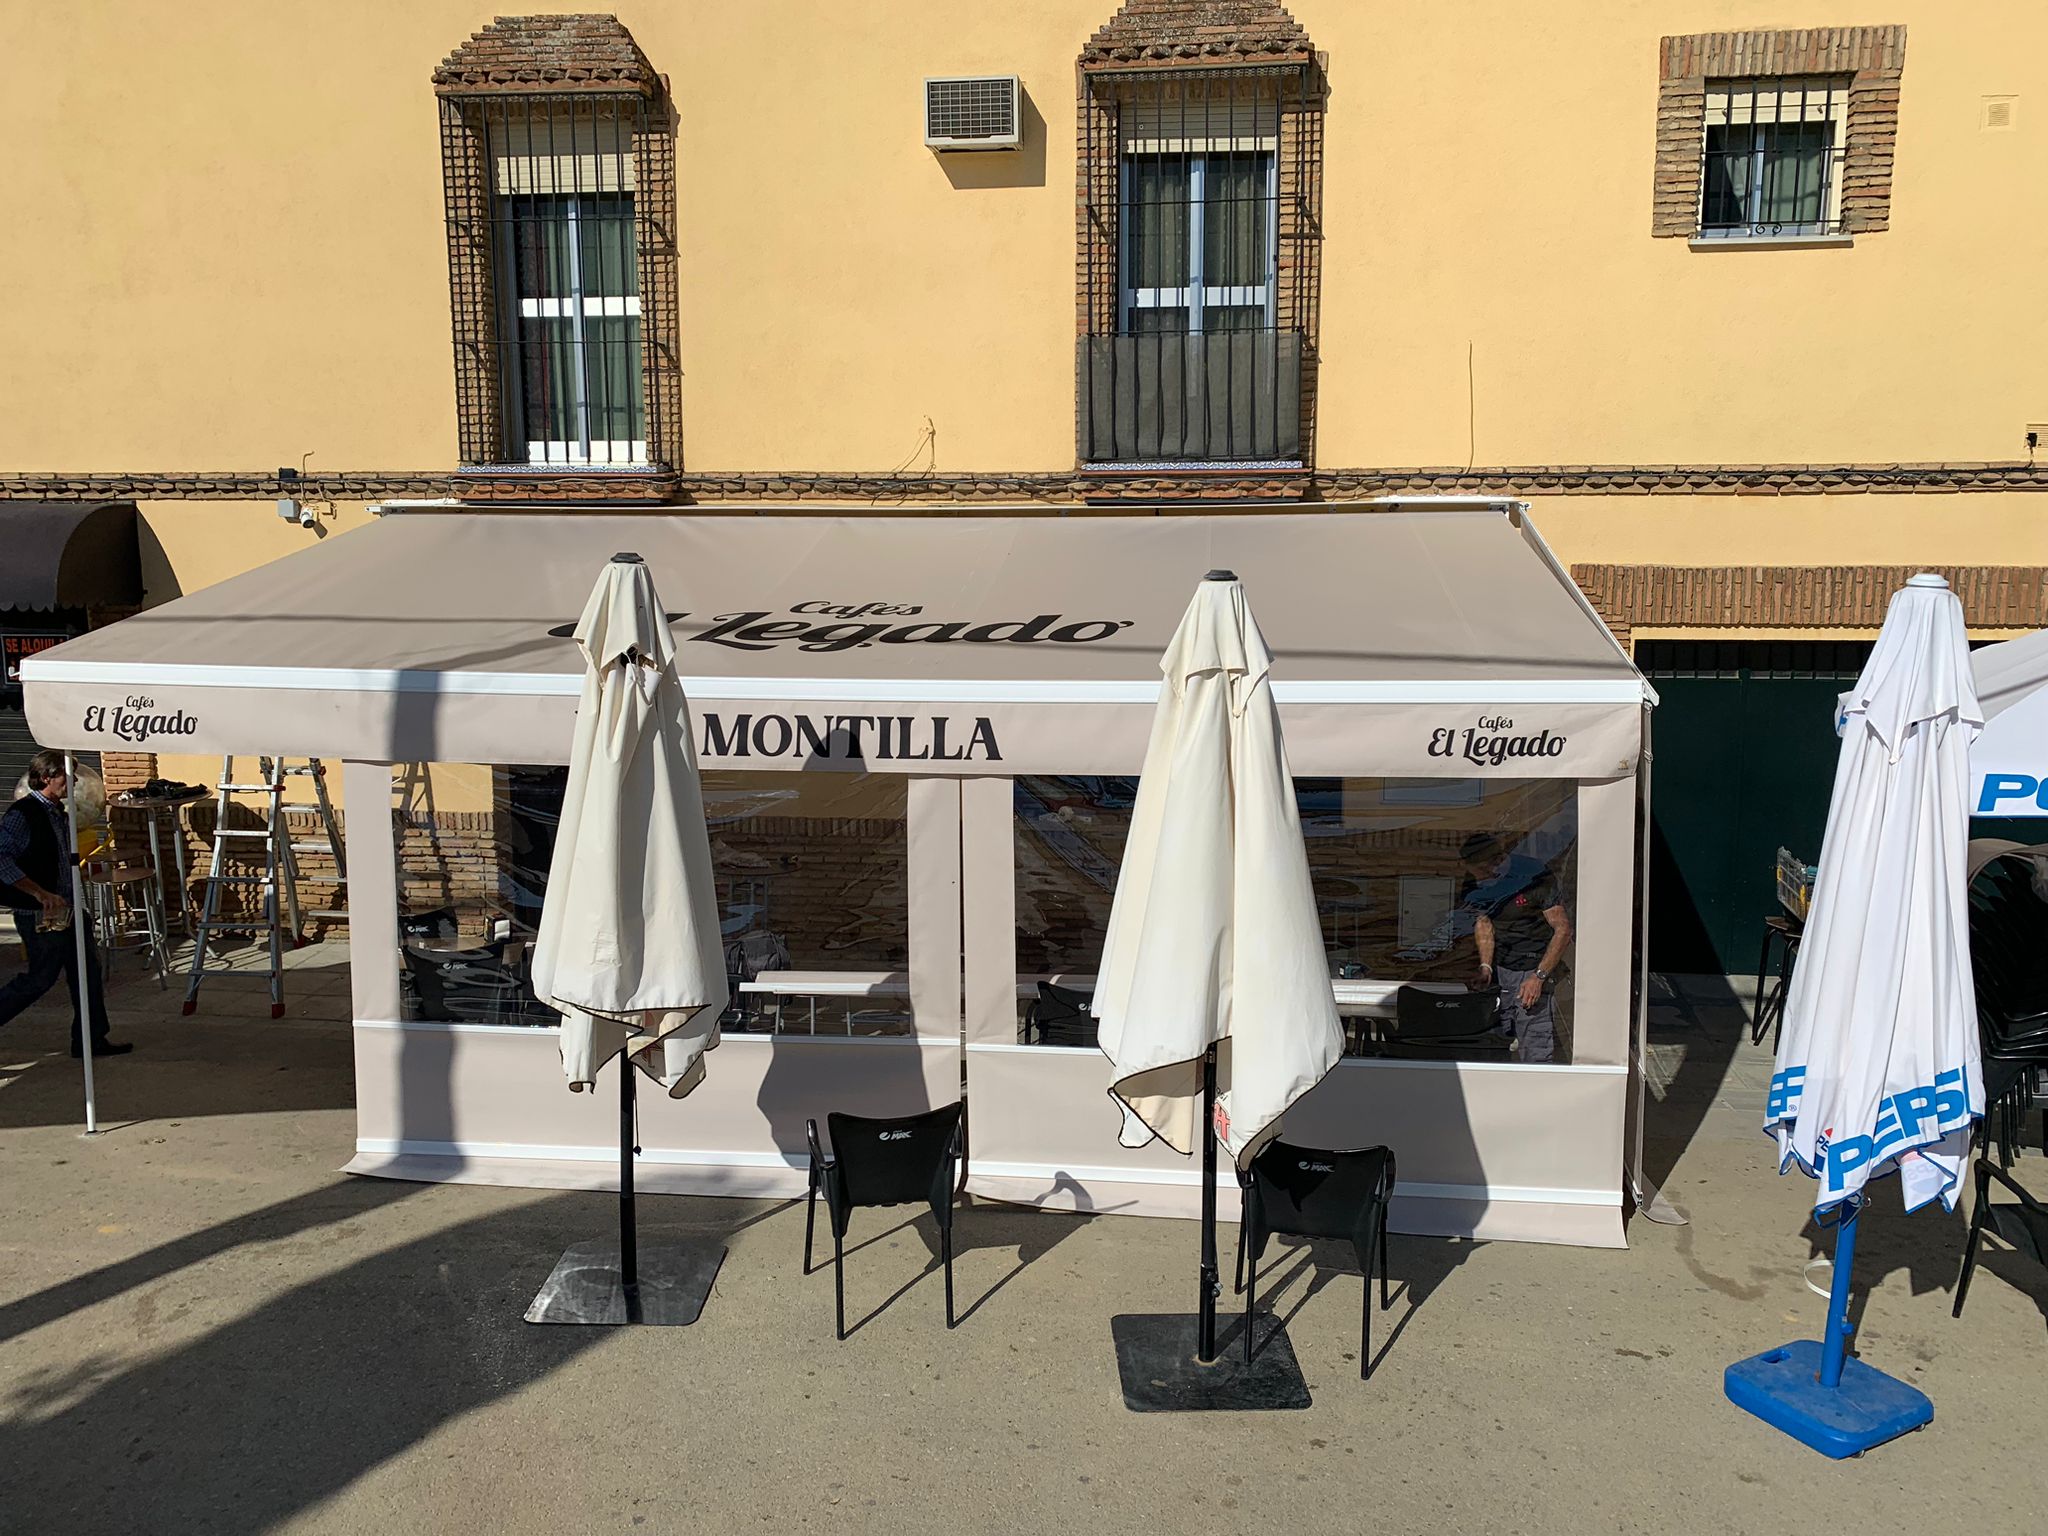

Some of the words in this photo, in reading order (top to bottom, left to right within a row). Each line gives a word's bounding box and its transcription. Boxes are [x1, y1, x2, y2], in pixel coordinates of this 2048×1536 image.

[789, 600, 924, 618] Cafés
[5, 638, 19, 653] SE
[686, 611, 1134, 653] Legado
[125, 695, 155, 711] Cafés
[83, 705, 106, 732] El
[111, 706, 199, 742] Legado
[701, 713, 1003, 760] MONTILLA
[1478, 715, 1513, 732] Cafés
[1427, 727, 1456, 757] El
[1461, 728, 1567, 766] Legado
